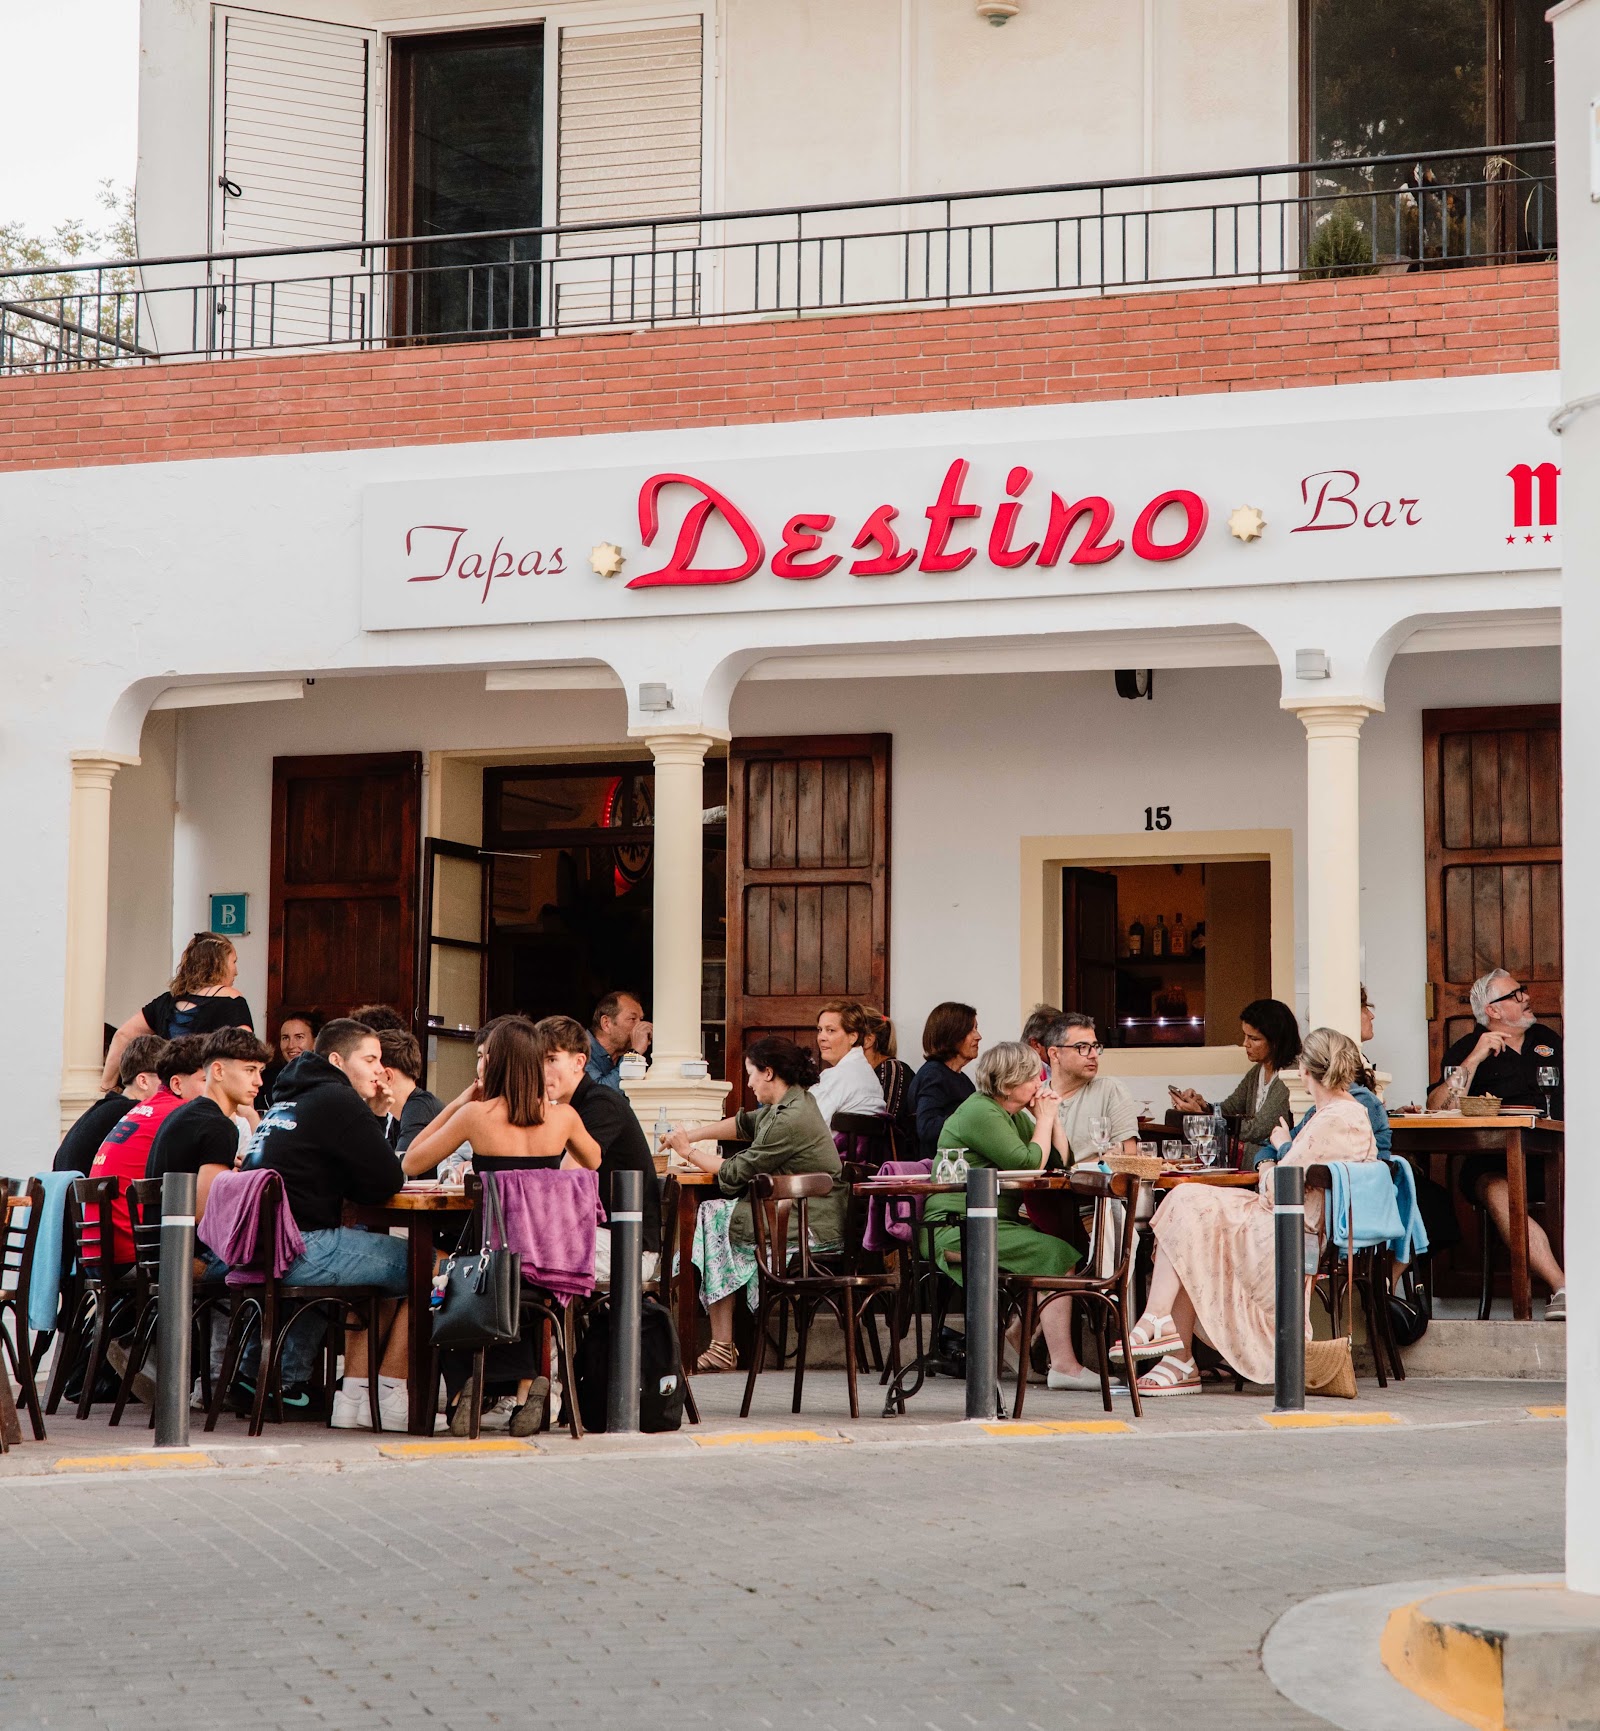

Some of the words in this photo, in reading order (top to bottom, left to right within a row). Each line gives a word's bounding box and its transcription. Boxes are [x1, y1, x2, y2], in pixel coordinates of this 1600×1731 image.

[624, 457, 1210, 590] Destino
[1289, 469, 1424, 534] Bar
[405, 524, 567, 603] Tapas
[1144, 805, 1172, 831] 15
[221, 904, 237, 926] B
